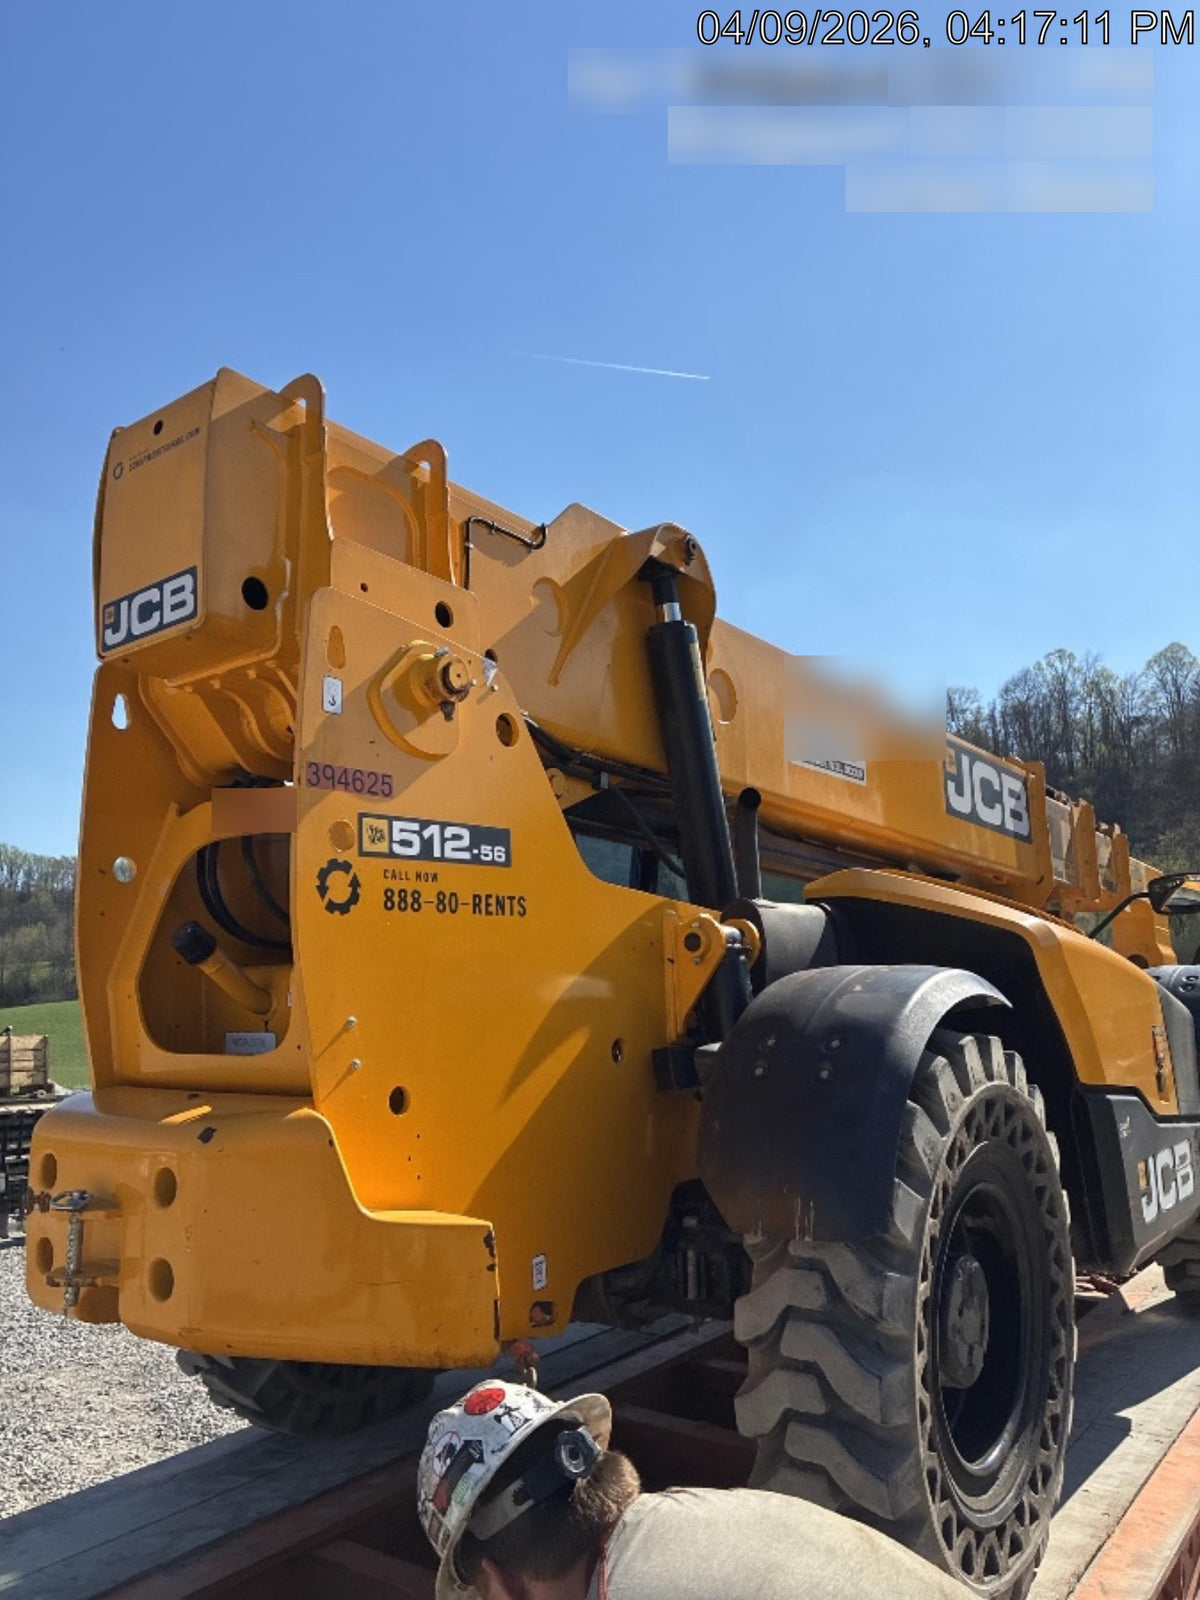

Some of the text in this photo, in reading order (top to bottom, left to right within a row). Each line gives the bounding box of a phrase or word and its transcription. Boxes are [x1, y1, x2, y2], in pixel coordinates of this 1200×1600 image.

[104, 573, 195, 646] JCB
[306, 762, 393, 797] 394625
[947, 753, 1030, 836] JCB
[391, 820, 506, 863] 512-56
[383, 869, 438, 883] CALL NOW
[383, 888, 527, 917] 888-80-RENTS
[1141, 1139, 1194, 1224] JCB
